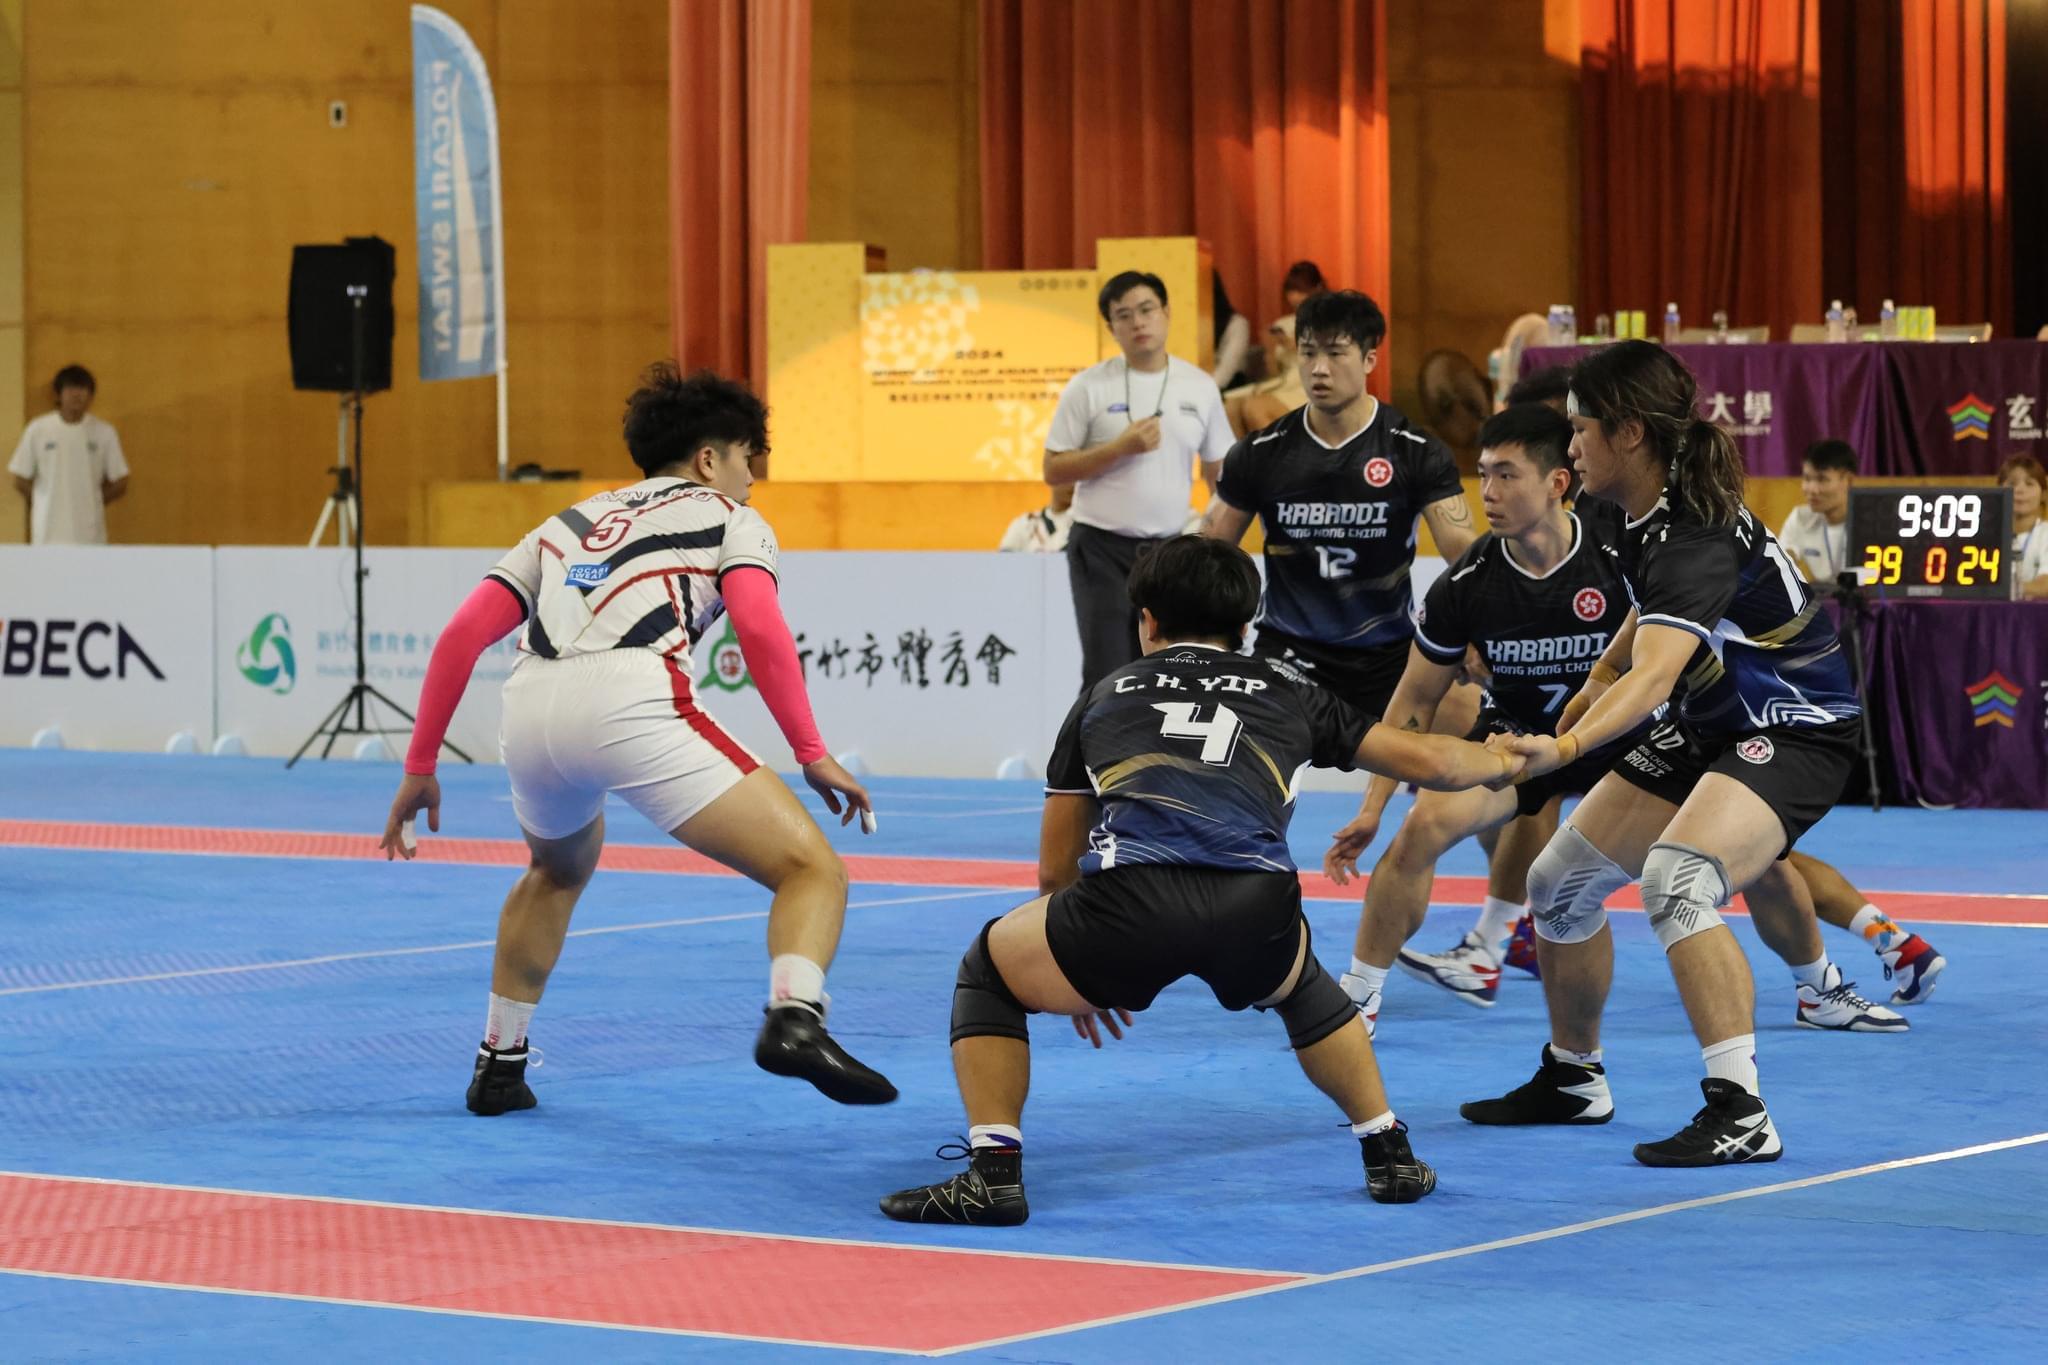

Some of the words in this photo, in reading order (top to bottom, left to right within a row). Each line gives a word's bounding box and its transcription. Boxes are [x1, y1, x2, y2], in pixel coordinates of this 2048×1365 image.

[1706, 391, 1772, 425] 大學
[2005, 394, 2048, 429] 玄
[1276, 502, 1389, 525] KABADDI
[1898, 495, 1981, 537] 9:09
[1284, 528, 1311, 538] ONG
[1348, 527, 1387, 538] CHINA
[1315, 545, 1358, 580] 12
[1864, 546, 1903, 585] 39
[1925, 547, 1947, 583] 0
[1956, 546, 2000, 585] 24
[0, 619, 166, 681] BECA
[1485, 632, 1609, 662] KABADDI
[1114, 675, 1146, 694] C.
[1155, 673, 1188, 691] H.
[1197, 675, 1268, 695] YIP
[1493, 664, 1523, 675] HONG
[1527, 664, 1562, 676] KONG
[1565, 660, 1596, 673] CHI
[1538, 683, 1570, 713] 7
[1150, 702, 1243, 767] 4
